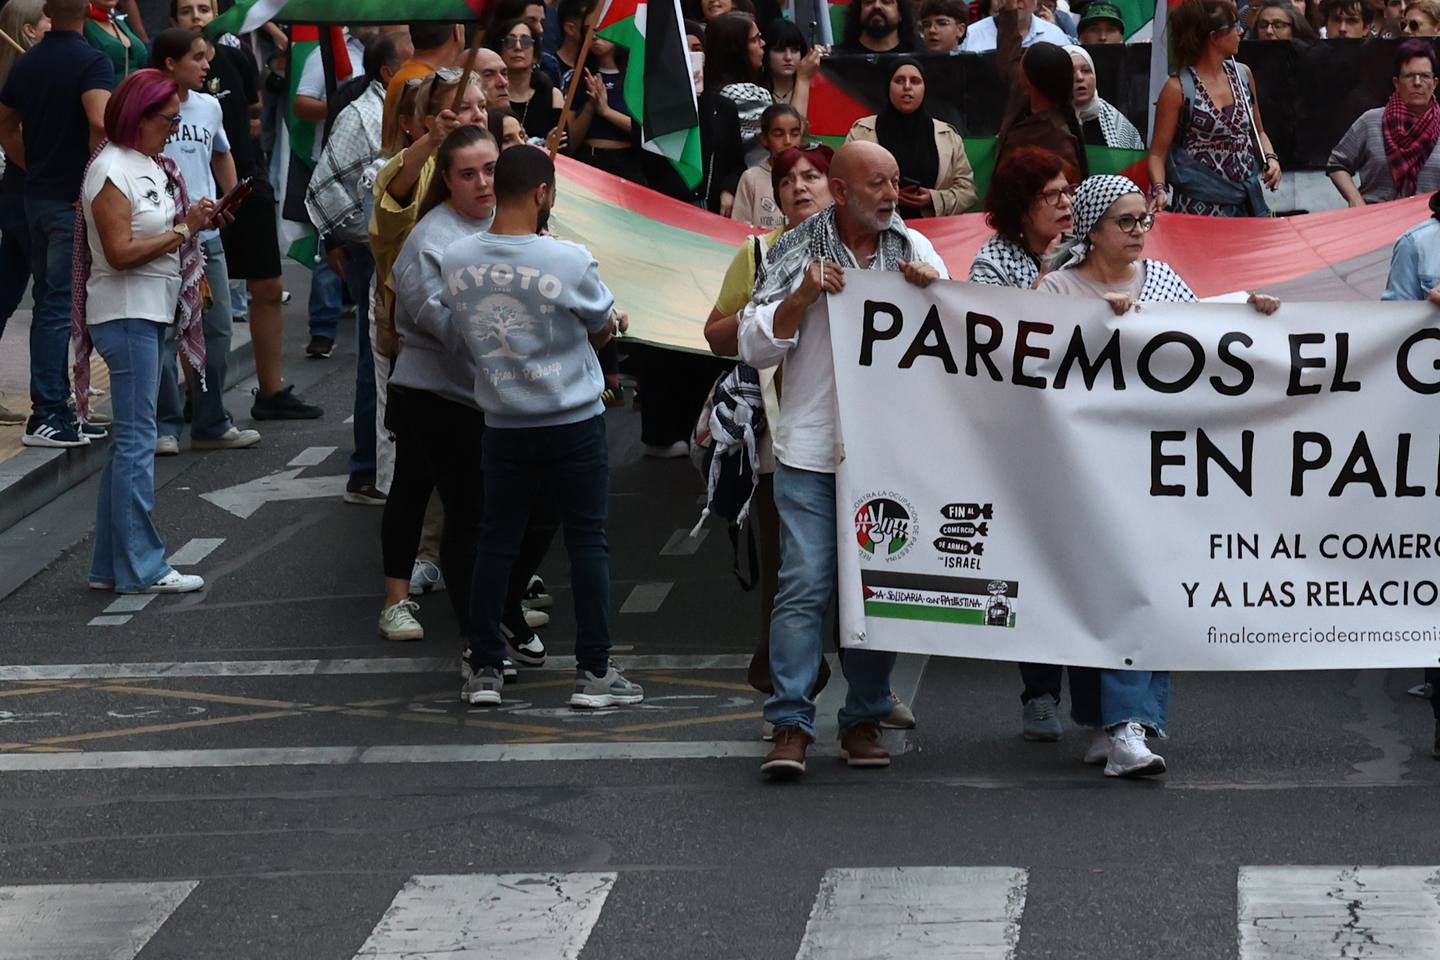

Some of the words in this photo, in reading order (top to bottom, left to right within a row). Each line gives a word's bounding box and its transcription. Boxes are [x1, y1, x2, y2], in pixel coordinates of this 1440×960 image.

[448, 263, 562, 299] KYOTO
[858, 299, 1255, 396] PAREMOS
[1286, 332, 1361, 396] EL
[1150, 428, 1254, 497] EN
[949, 506, 966, 518] FIN
[967, 507, 974, 515] AL
[943, 526, 975, 534] COMERCIO
[947, 542, 968, 552] ARMAS
[1210, 533, 1259, 559] FIN
[1271, 533, 1307, 559] AL
[945, 556, 981, 570] ISRAEL
[1181, 582, 1200, 608] Y
[1211, 581, 1232, 607] A
[1243, 581, 1295, 607] LAS
